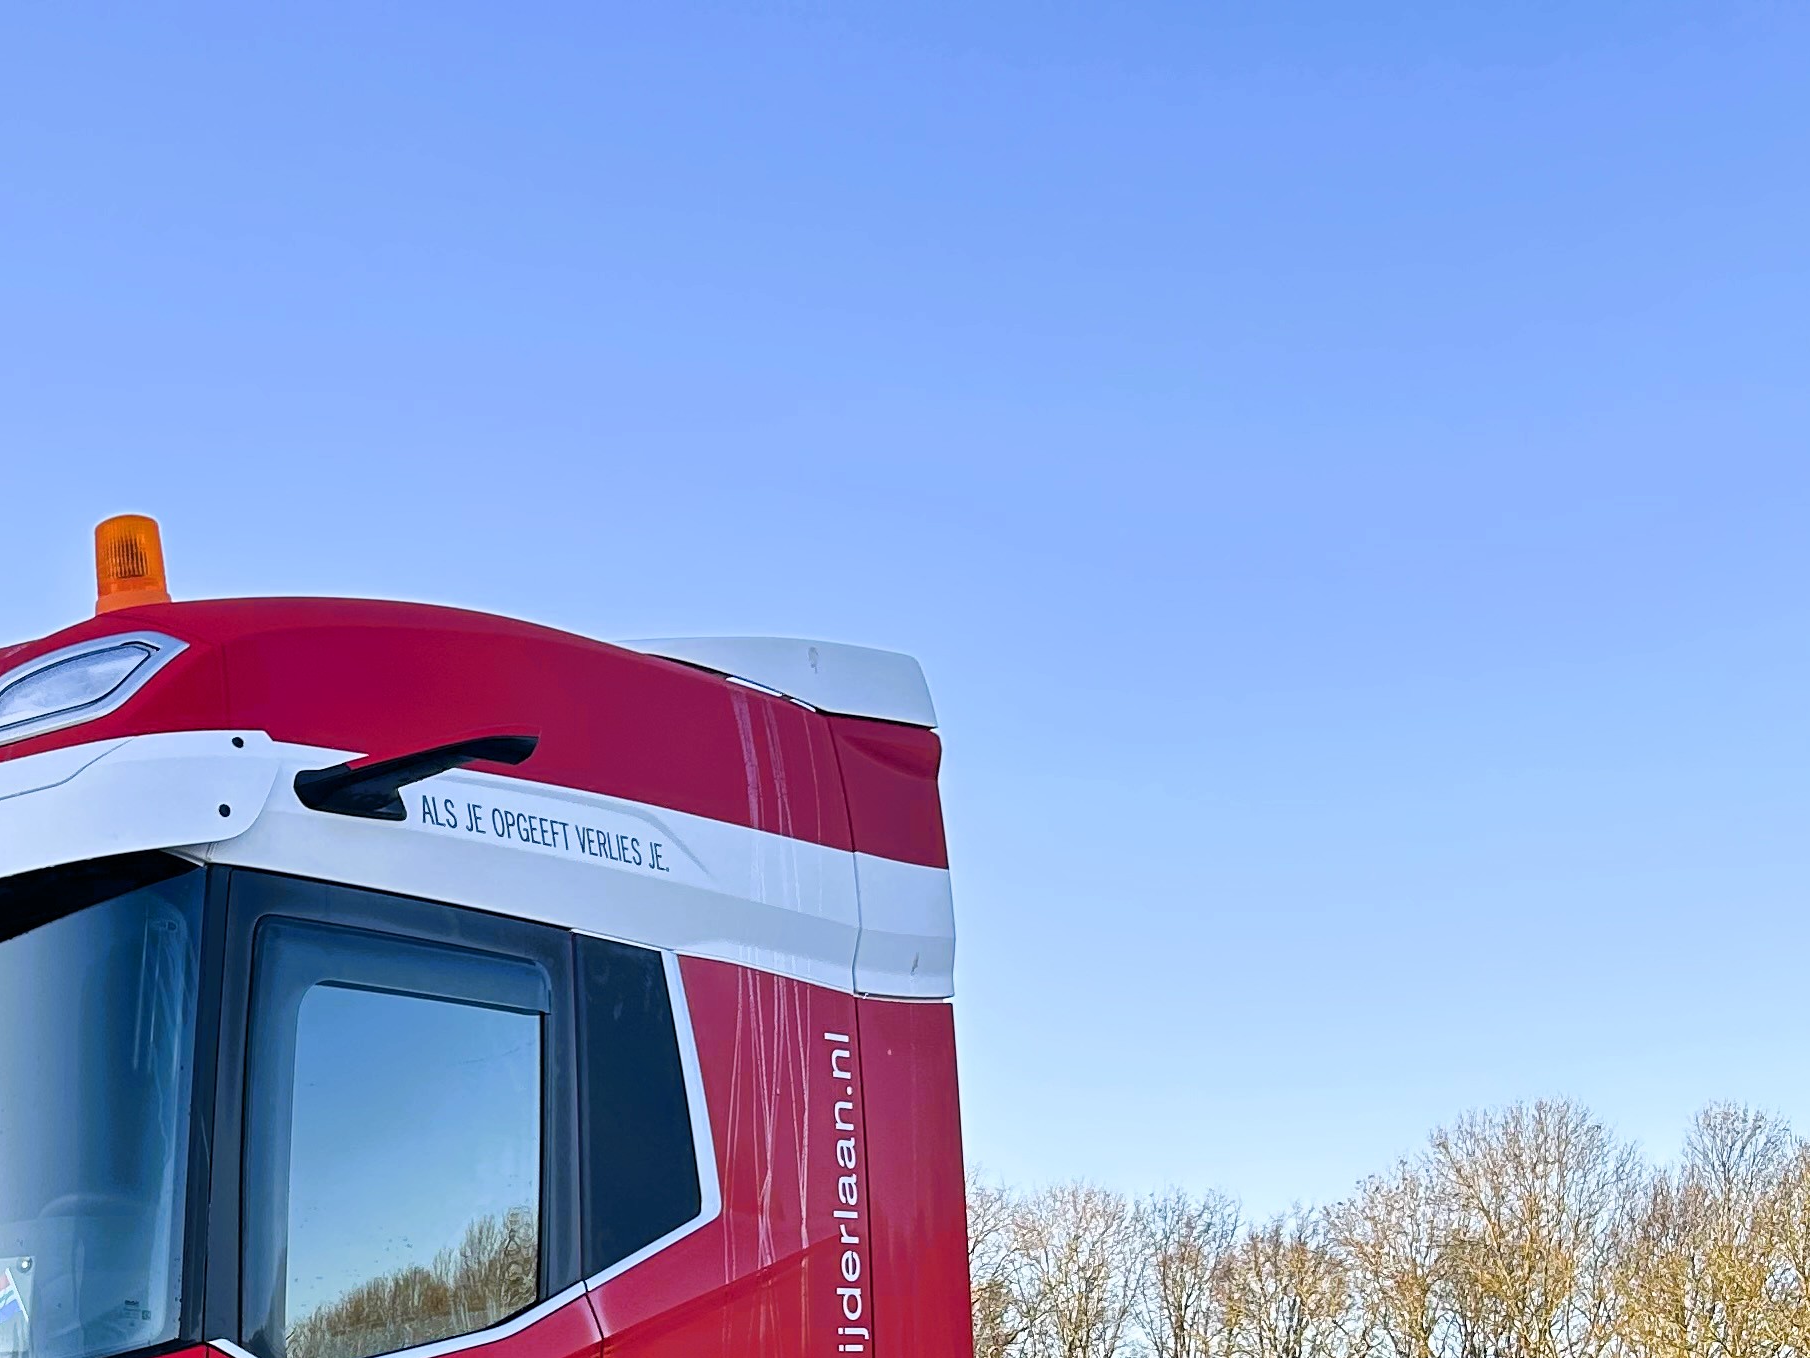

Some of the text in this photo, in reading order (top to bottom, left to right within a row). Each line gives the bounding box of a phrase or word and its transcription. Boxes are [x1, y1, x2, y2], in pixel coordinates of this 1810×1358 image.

[421, 795, 670, 873] ALS JE OPGEEFT VERLIES JE.
